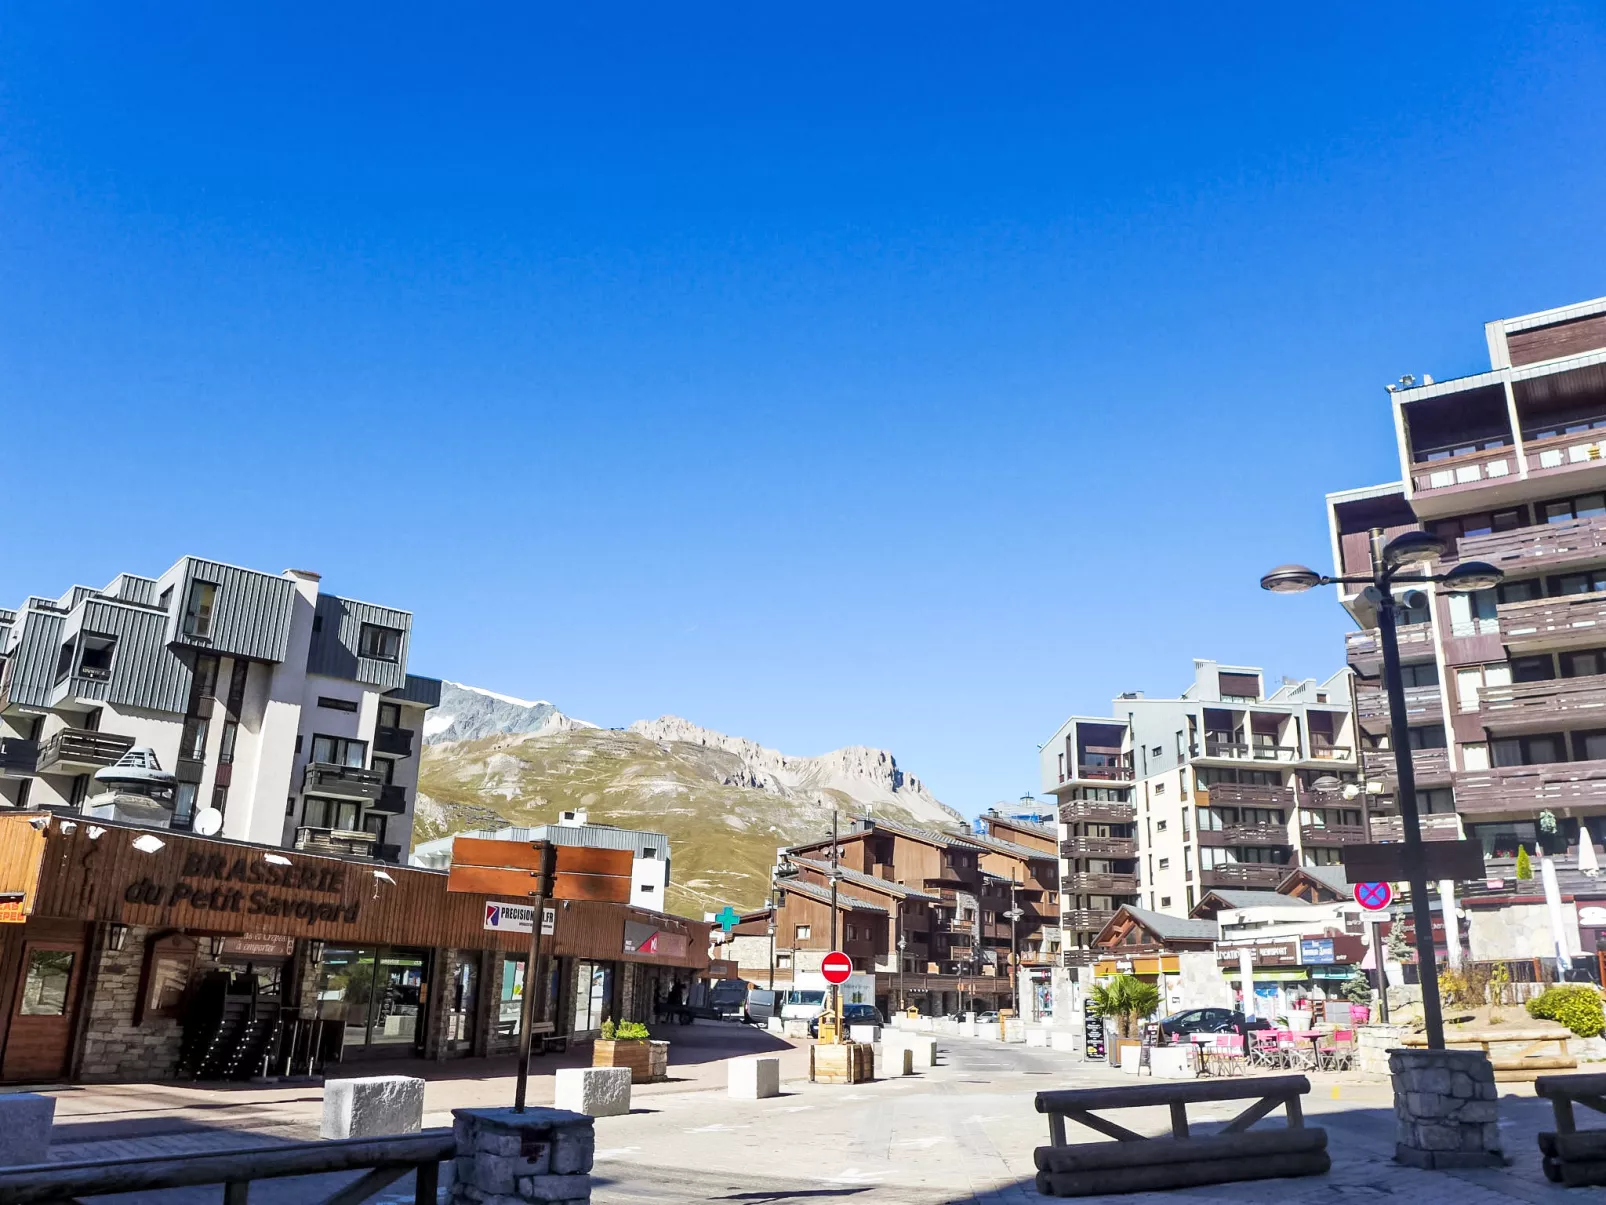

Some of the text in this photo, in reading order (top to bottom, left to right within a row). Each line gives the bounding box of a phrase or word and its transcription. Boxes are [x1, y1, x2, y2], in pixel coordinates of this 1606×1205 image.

[183, 851, 346, 893] BRASSERIE
[124, 877, 360, 925] du Petit Savoyard
